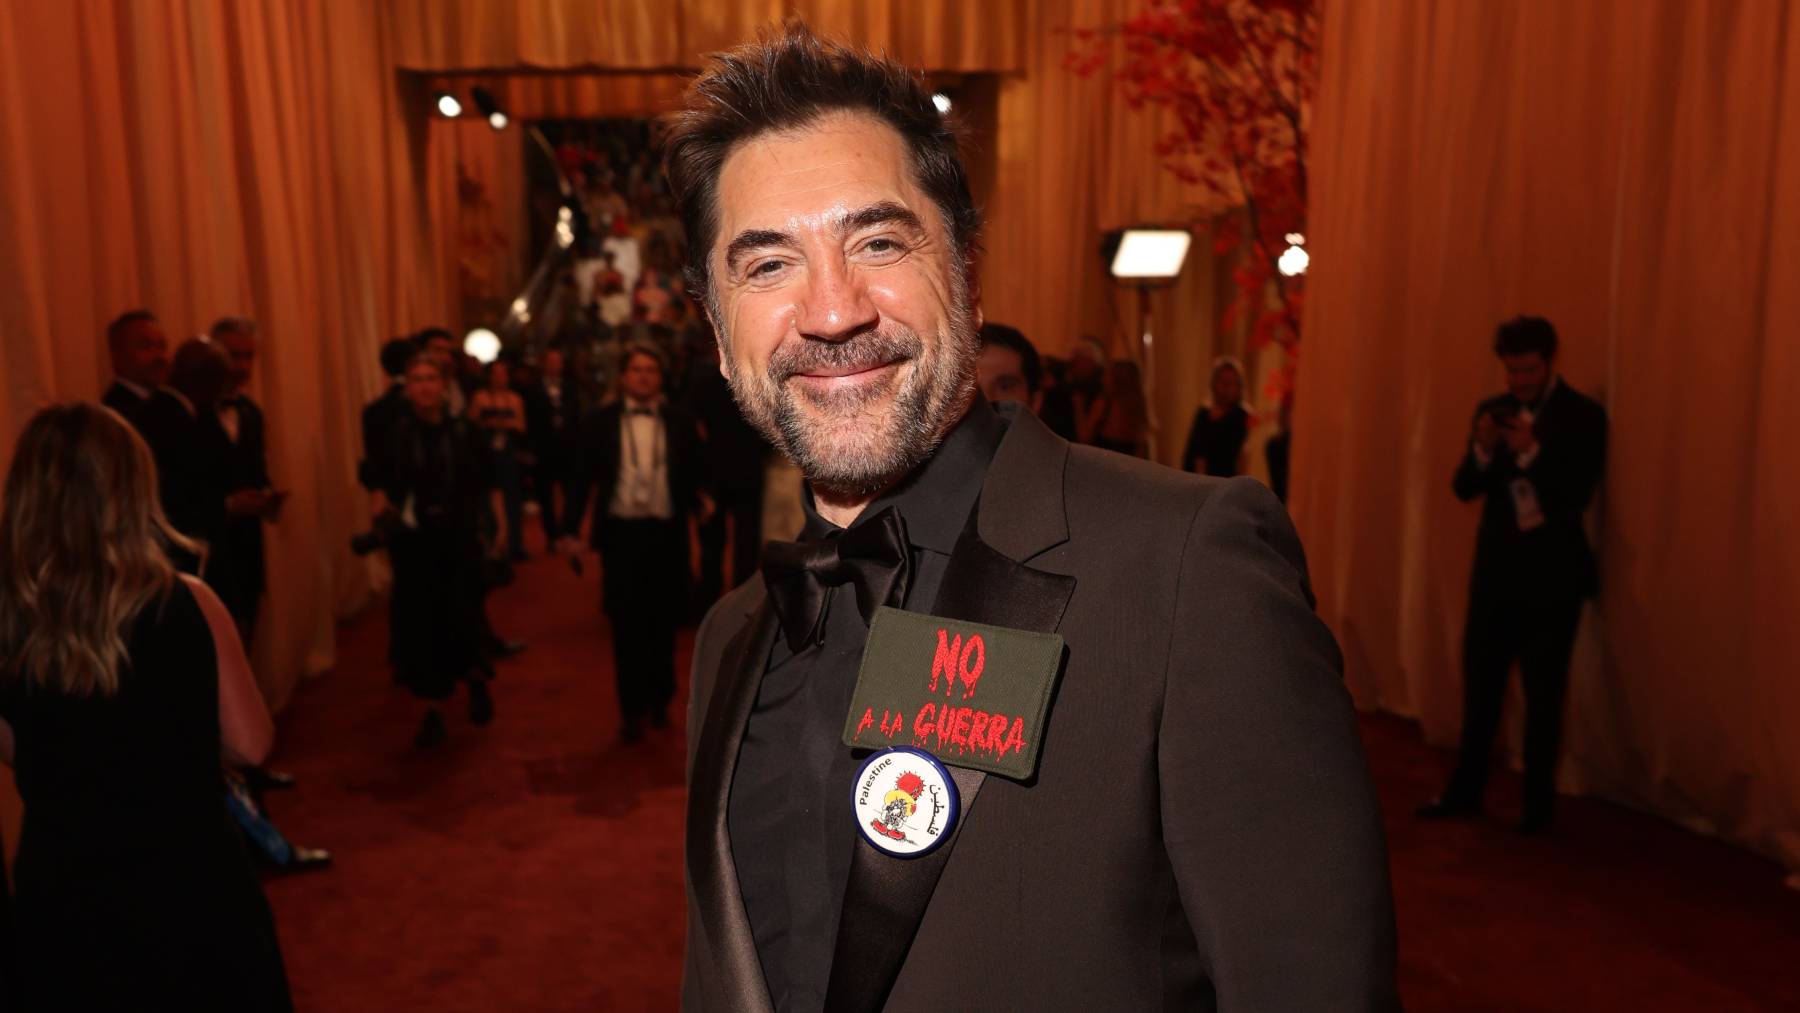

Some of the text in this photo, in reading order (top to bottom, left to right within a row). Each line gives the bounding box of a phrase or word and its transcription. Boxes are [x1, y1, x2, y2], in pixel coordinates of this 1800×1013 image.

[929, 627, 986, 700] NO
[853, 702, 1027, 763] A LA GUERRA
[859, 757, 893, 806] Palestine
[926, 784, 945, 837] فلسطين
